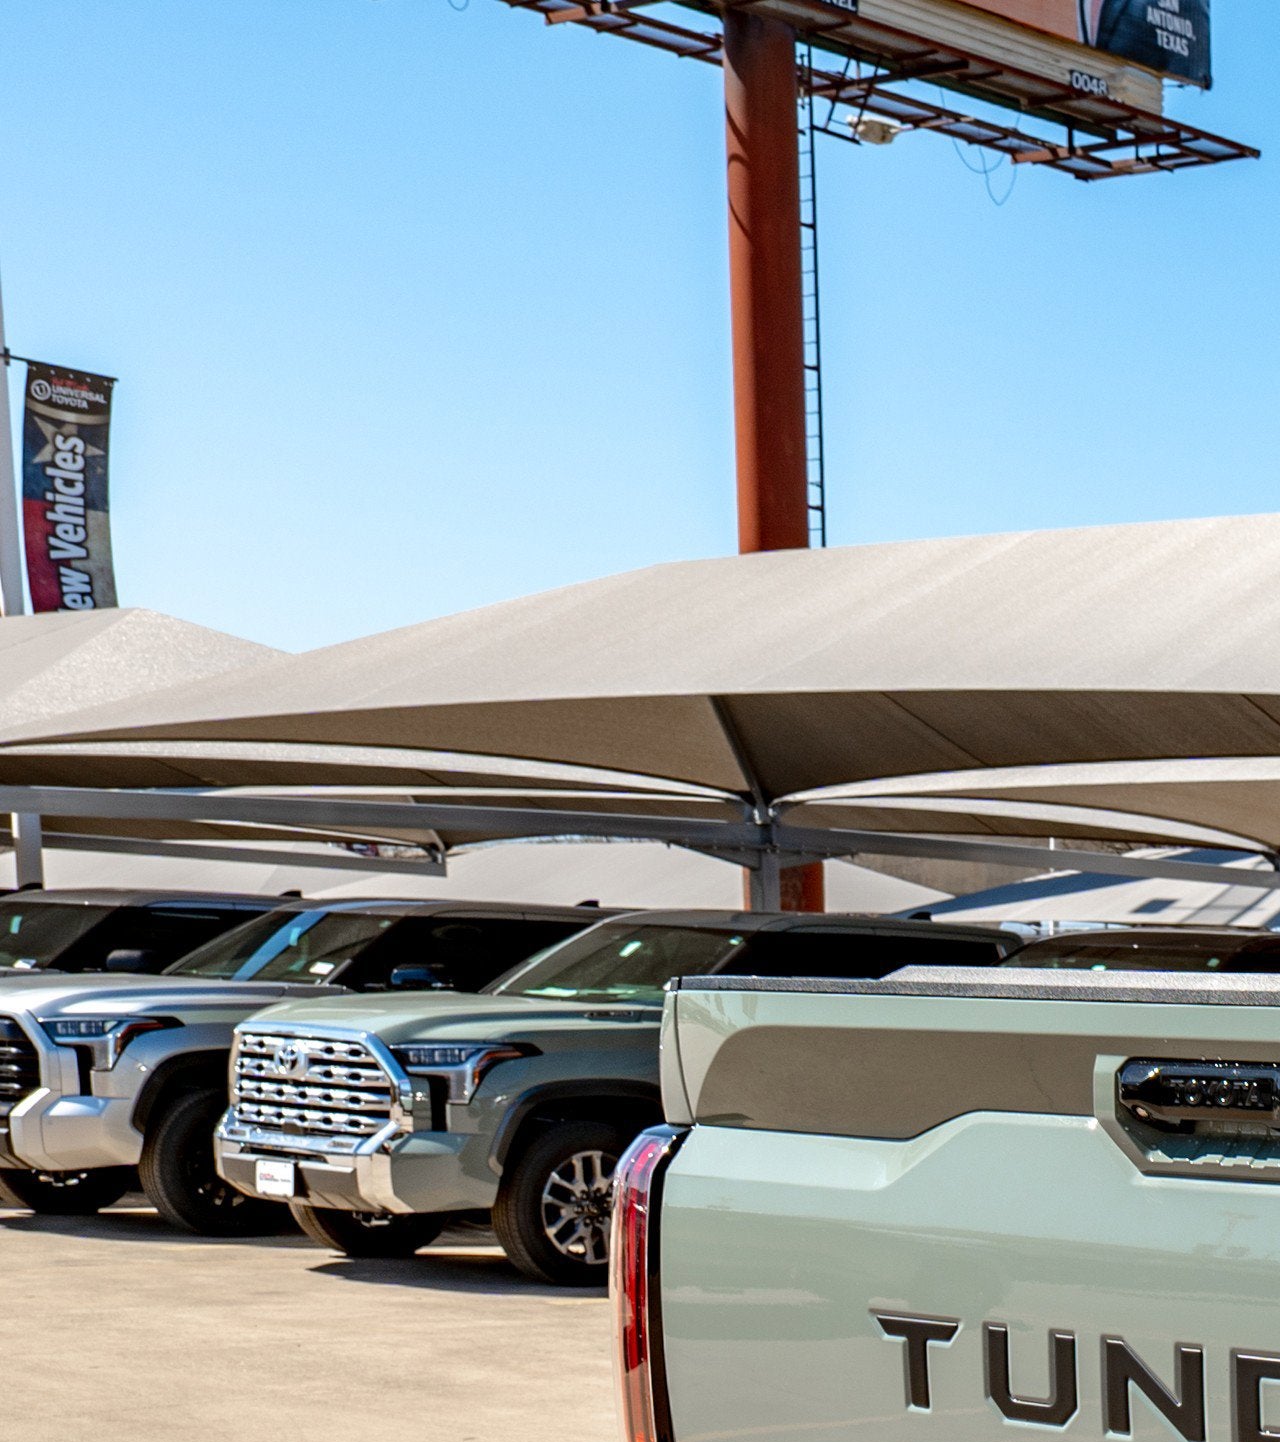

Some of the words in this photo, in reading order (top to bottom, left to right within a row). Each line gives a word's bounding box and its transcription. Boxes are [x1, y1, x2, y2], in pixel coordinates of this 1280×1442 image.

[1155, 28, 1190, 57] TEXAS
[52, 385, 107, 404] UNIVERSAL
[52, 394, 89, 410] TOYOTA
[45, 434, 87, 559] Vehicles
[59, 565, 95, 610] ew
[1168, 1077, 1265, 1107] TOYOTA
